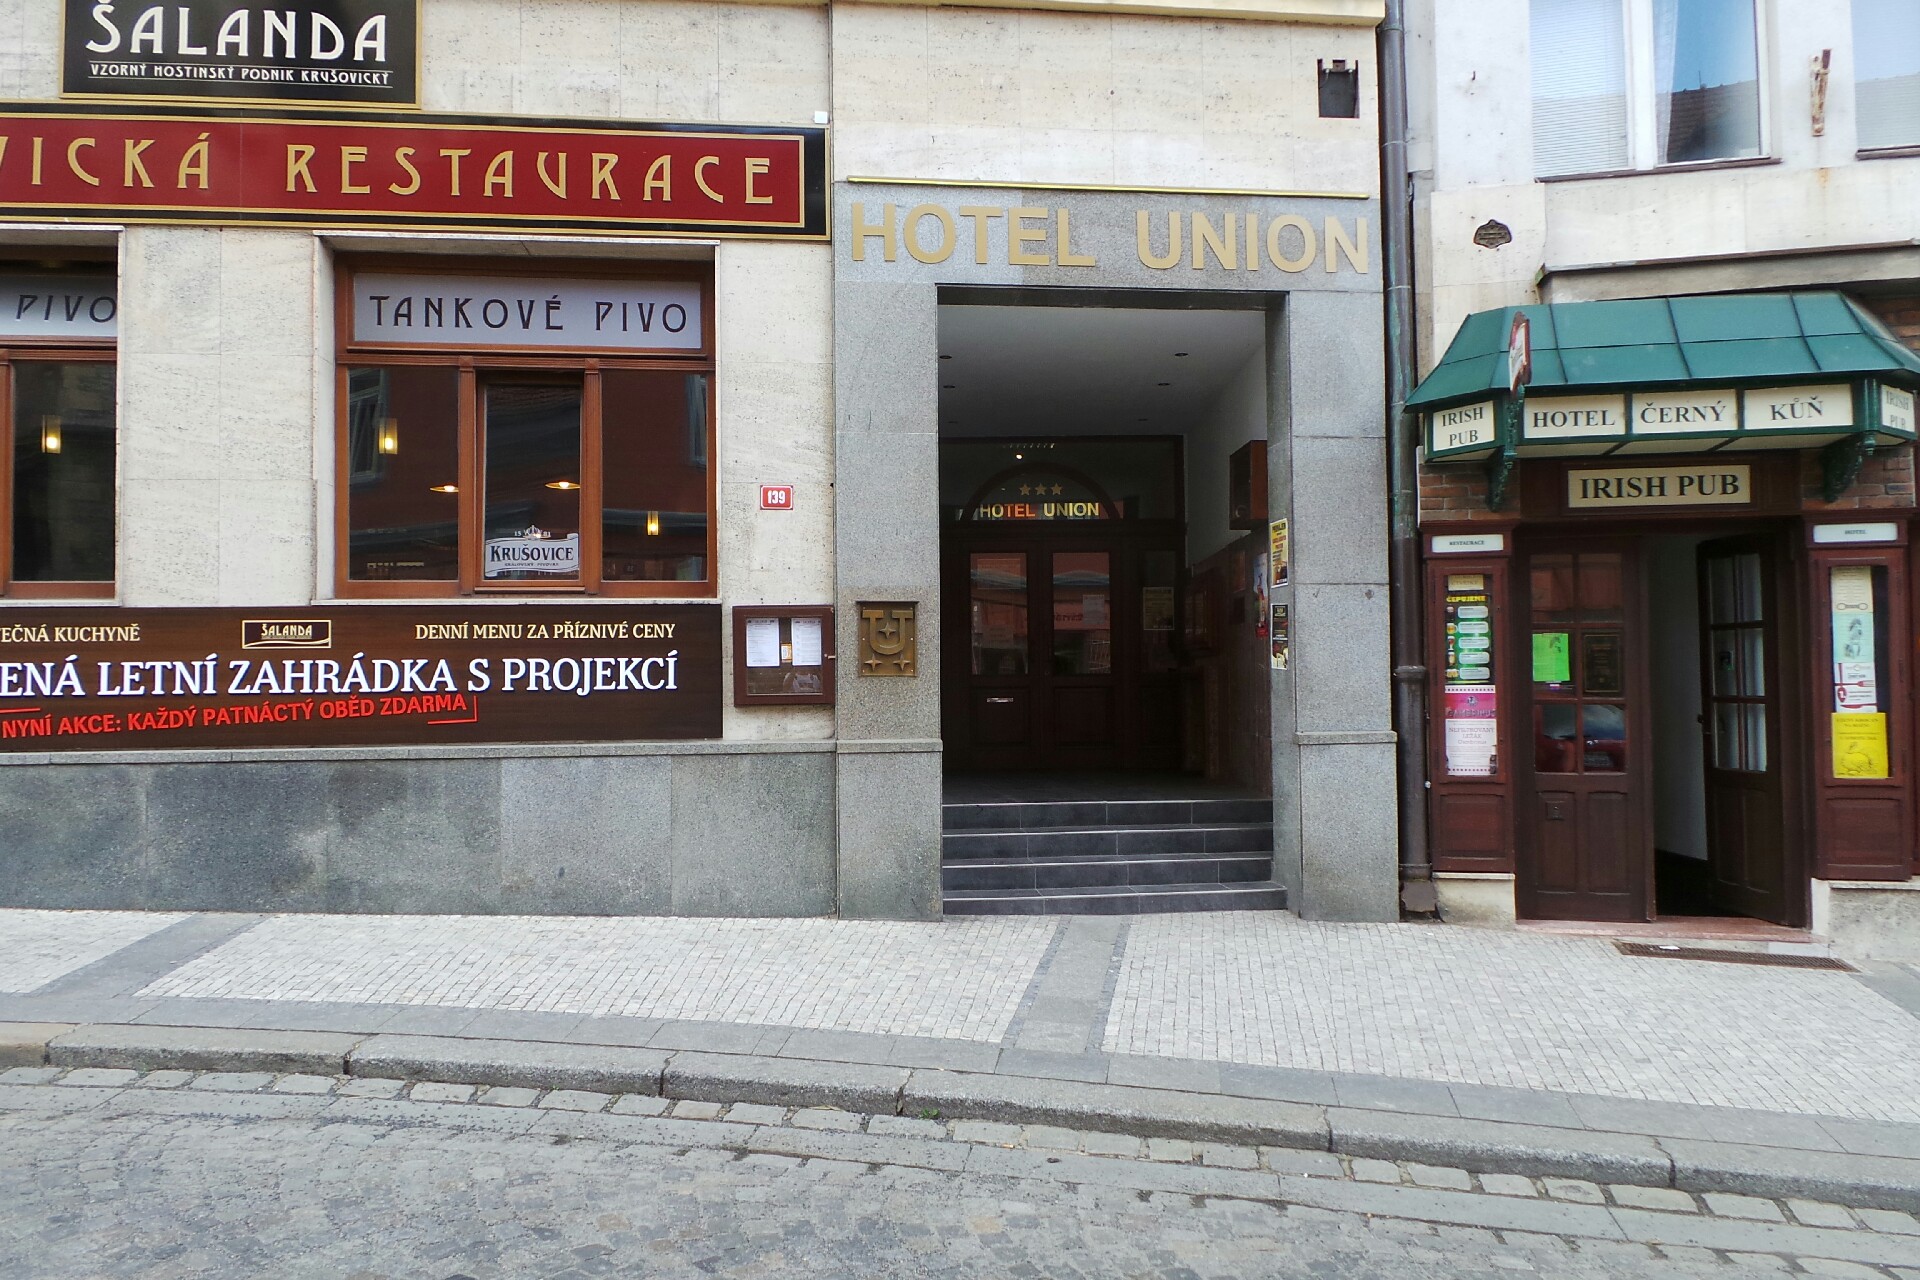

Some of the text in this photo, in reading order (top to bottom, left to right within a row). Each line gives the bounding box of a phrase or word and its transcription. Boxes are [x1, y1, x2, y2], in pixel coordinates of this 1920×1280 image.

[85, 0, 387, 62] ŠALANDA
[90, 62, 390, 85] VZORNÝ HOSTINSKÝ PODNIK KRUŠOVICKÝ
[286, 144, 773, 204] RESTAURACE
[851, 202, 1369, 275] HOTEL UNION
[16, 294, 117, 323] PIVO
[370, 294, 687, 333] TANKOVÉ PIVO
[1441, 406, 1484, 427] IRISH
[1533, 396, 1823, 428] HOTEL ČERNÝ KŮŇ
[1449, 429, 1479, 447] PUB
[767, 490, 786, 504] 139
[1580, 474, 1739, 499] IRISH PUB
[979, 502, 1099, 518] HOTEL UNION
[490, 543, 574, 562] KRUŠOVICE
[0, 623, 140, 642] EČNÁ KUCHYNĚ
[261, 623, 312, 636] ŠALANDA
[415, 621, 676, 639] DENNÍ MENU ZA PŘÍZNIVÉ CENY
[0, 650, 678, 696] ENÁ LETNÍ ZAHRÁDKA S PROJEKCÍ
[2, 693, 467, 738] NYNÍ AKCE: KAŽDÝ PATNÁCTÝ OBĚD ZDARMA
